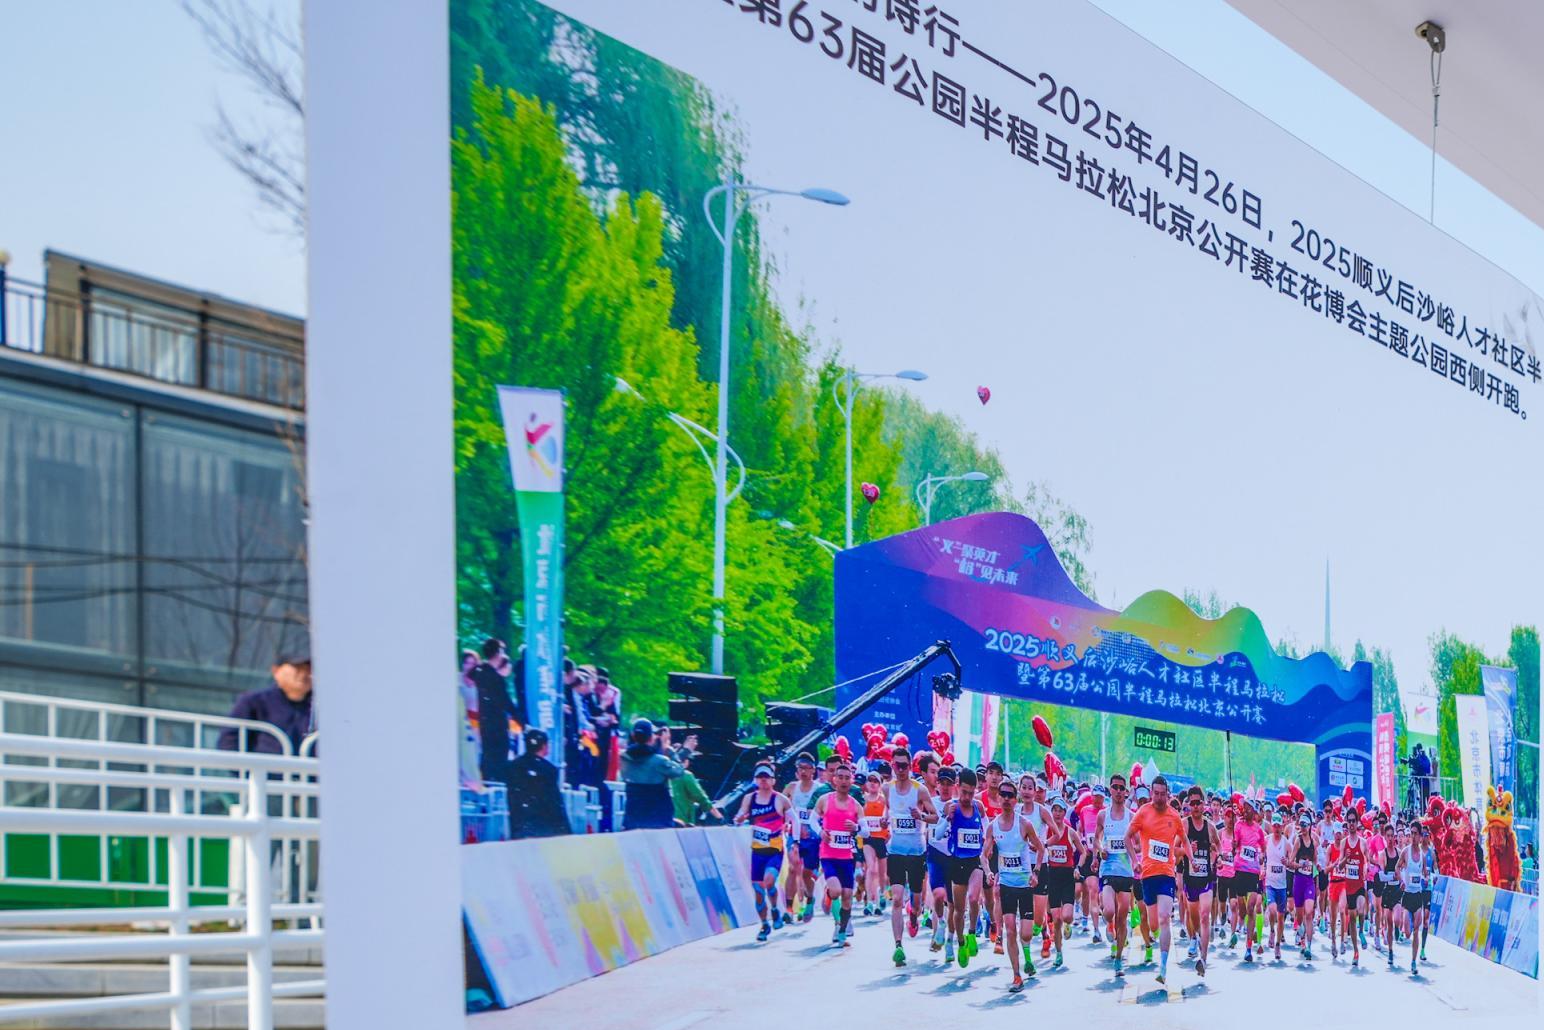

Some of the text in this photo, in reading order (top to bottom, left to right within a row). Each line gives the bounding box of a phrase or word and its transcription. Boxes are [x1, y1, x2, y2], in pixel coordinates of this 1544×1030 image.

[722, 0, 1528, 421] 第63届公园半程马拉松北京公开赛在花博会主题公园西侧开跑。
[850, 0, 1542, 384] 诗行——2025年4月26日，2025顺义后沙峪人才社区半
[984, 628, 1287, 703] 2025顺义后沙峪人才社区半程马拉松
[1016, 661, 1267, 725] 暨第63届公园半程马拉松北京公开赛
[1136, 733, 1175, 751] 0:00:13
